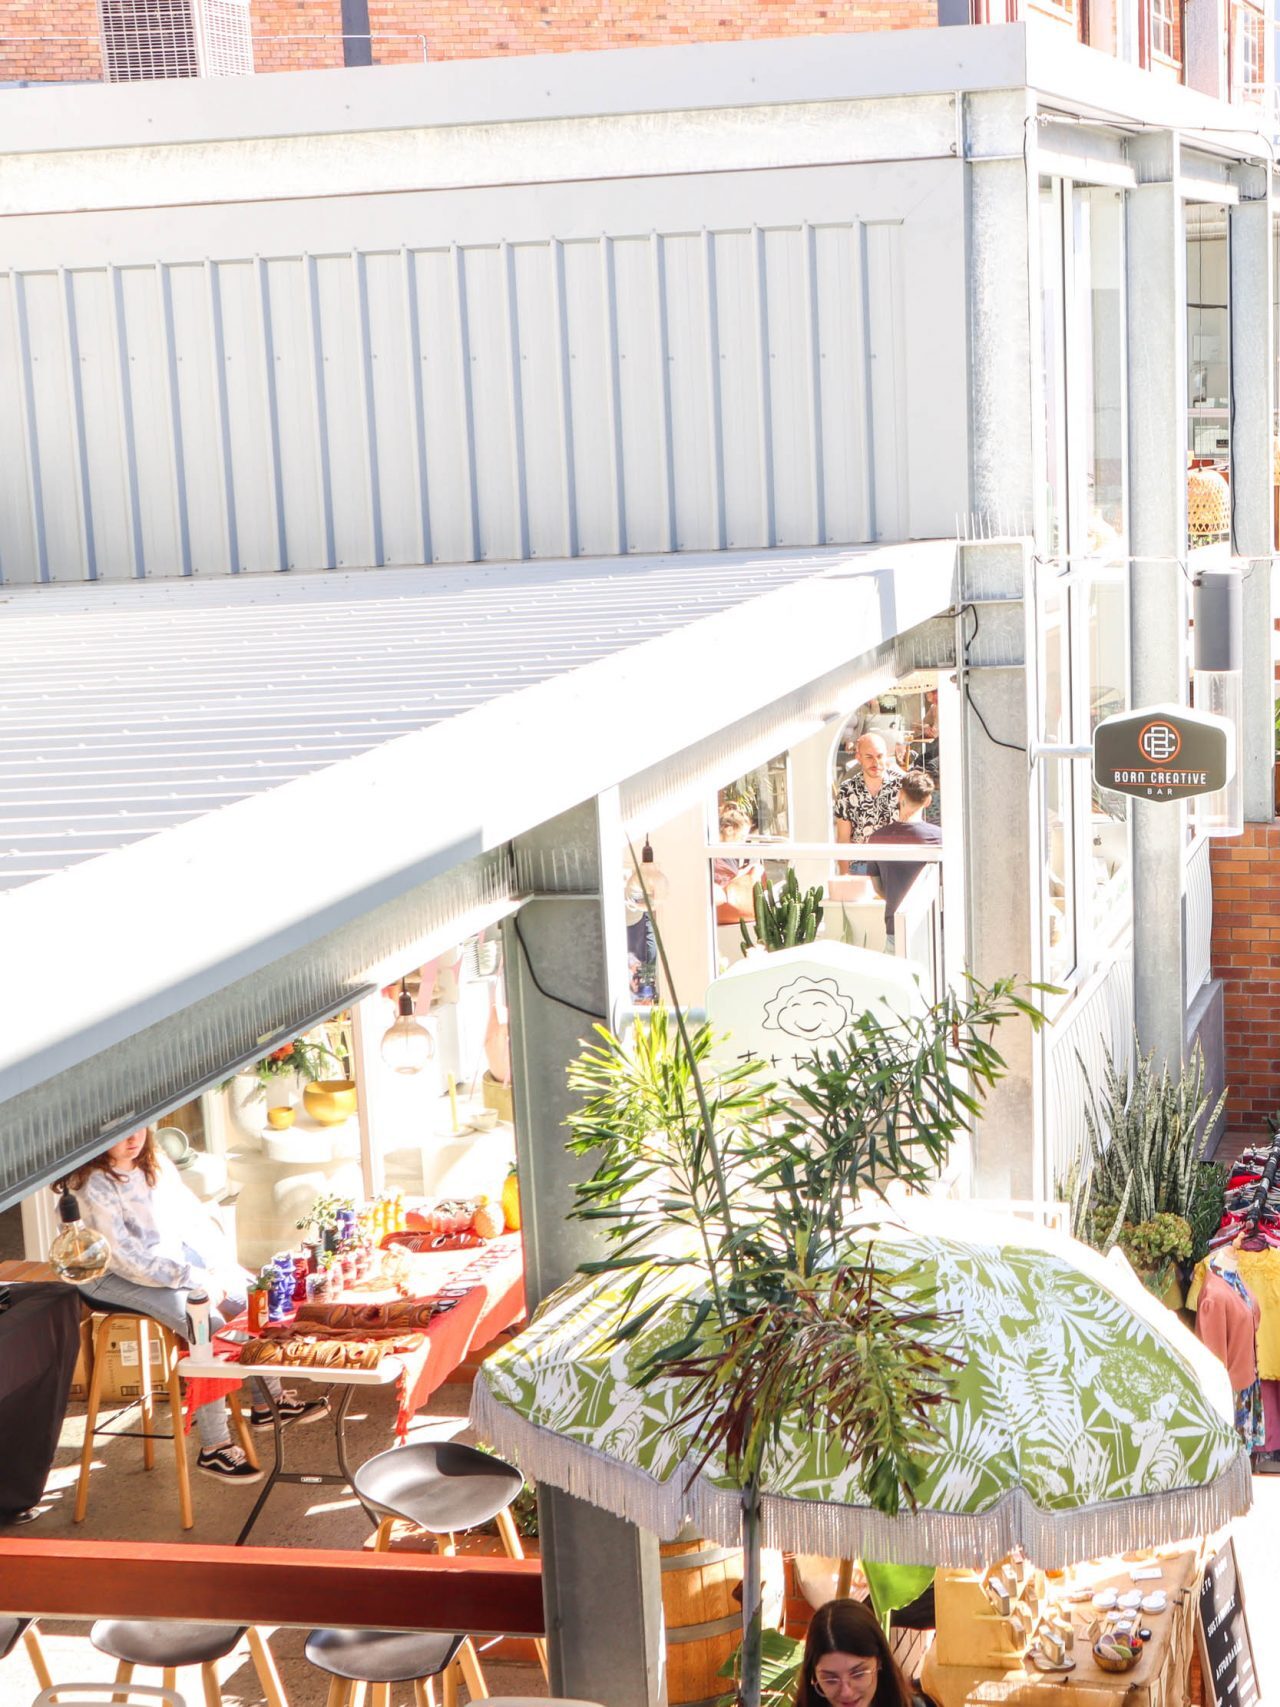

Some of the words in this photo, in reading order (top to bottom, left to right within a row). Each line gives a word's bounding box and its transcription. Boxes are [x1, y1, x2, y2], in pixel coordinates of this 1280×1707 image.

[1114, 770, 1145, 783] BORN
[1150, 771, 1207, 785] CREATIVE
[1147, 787, 1173, 796] BAR
